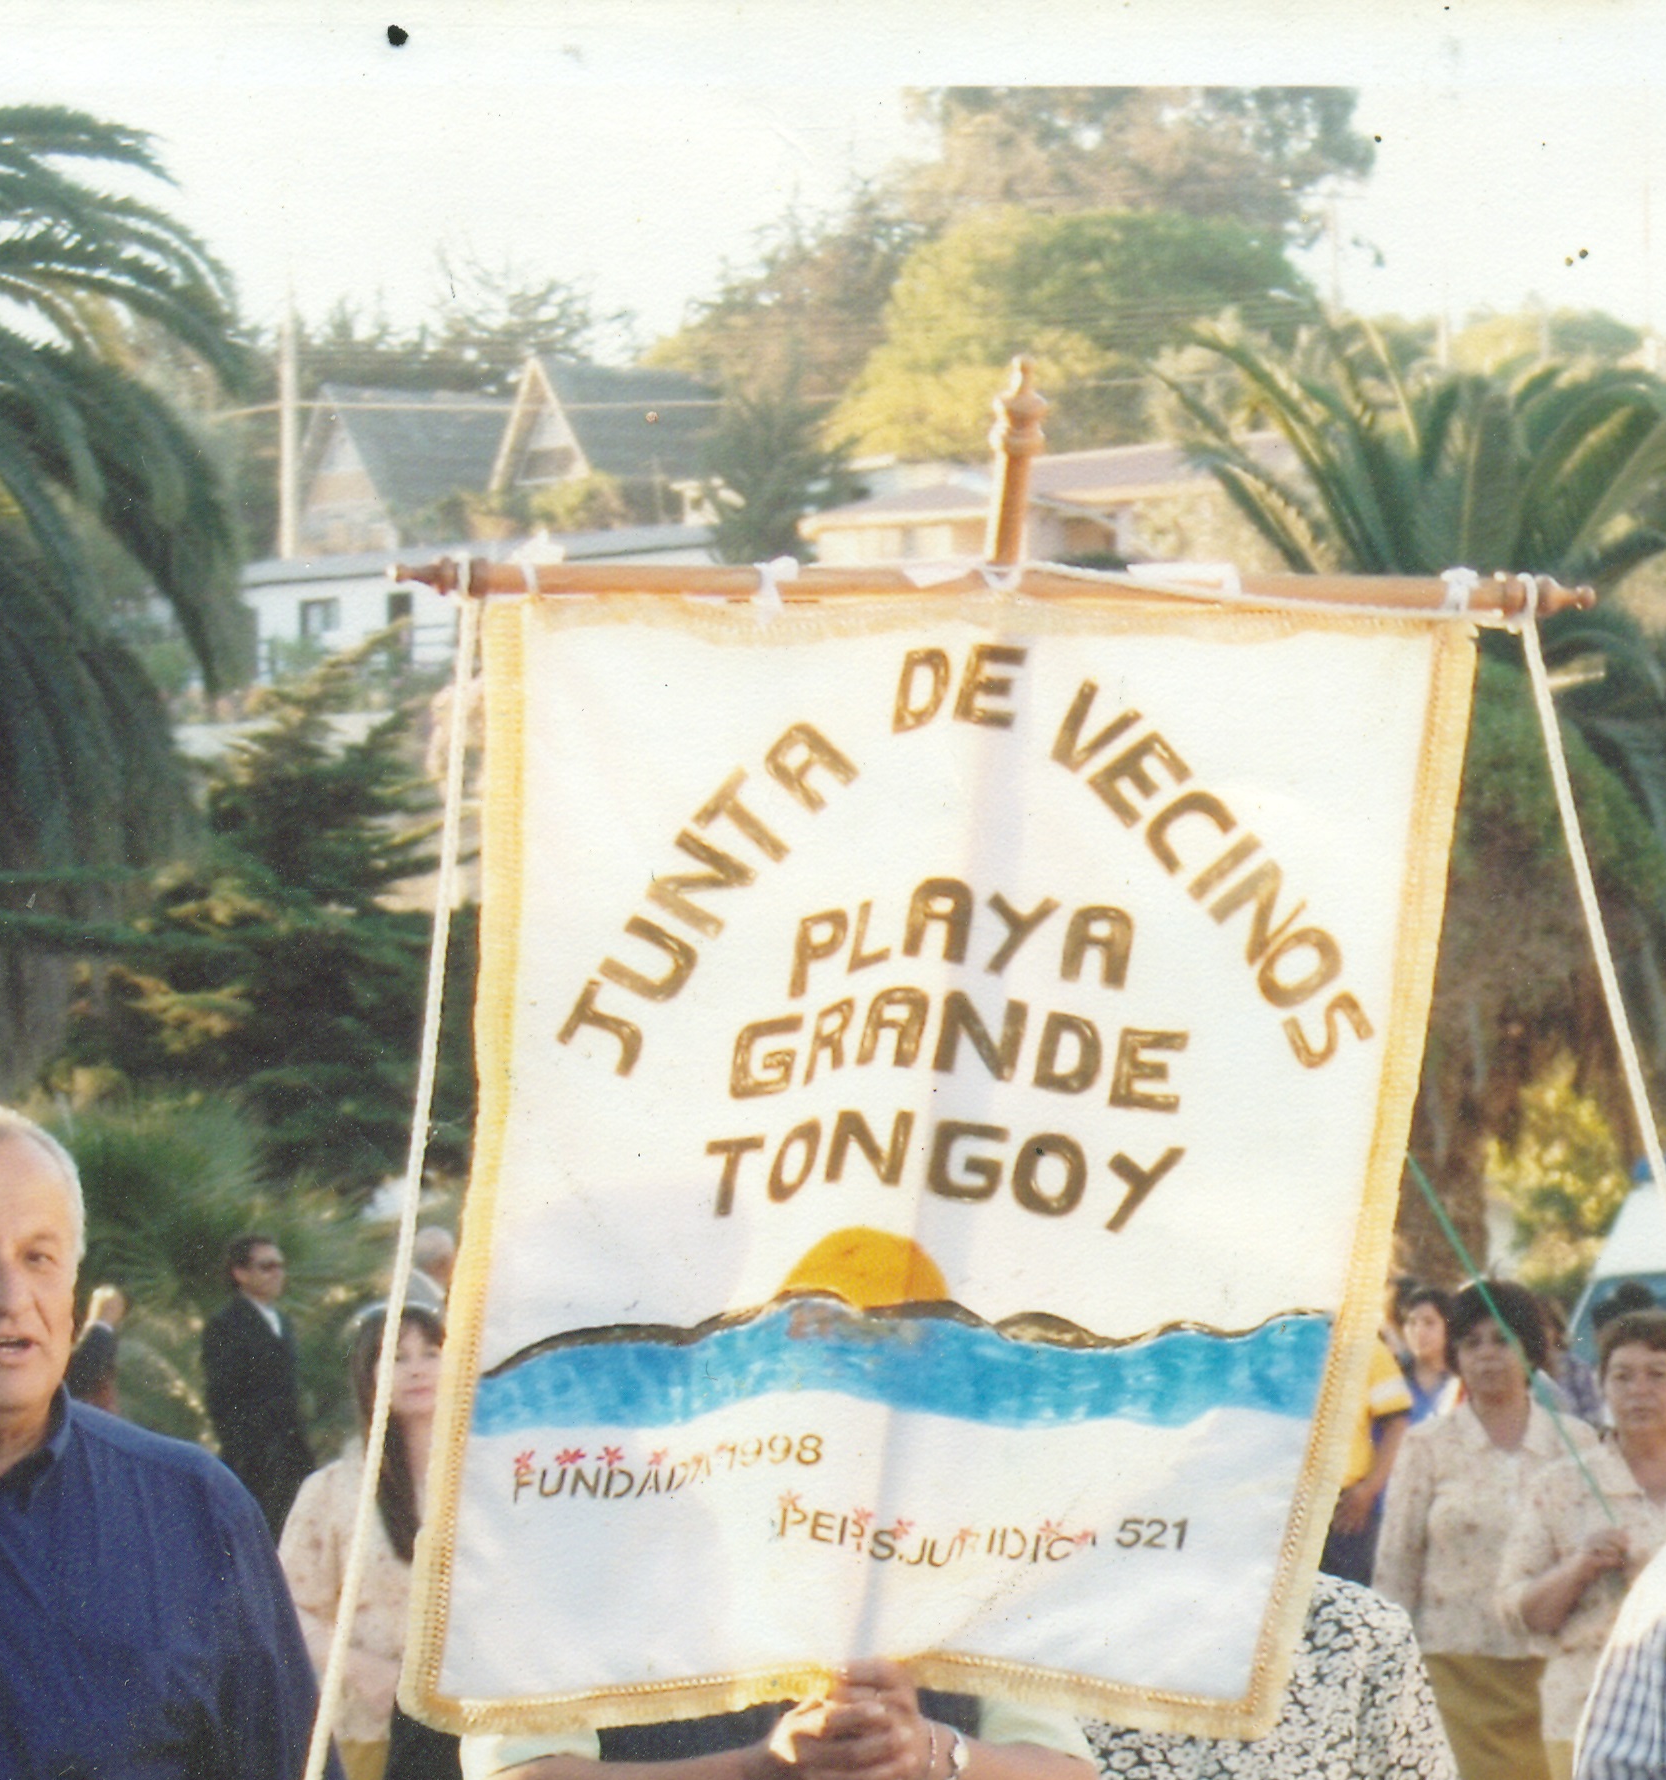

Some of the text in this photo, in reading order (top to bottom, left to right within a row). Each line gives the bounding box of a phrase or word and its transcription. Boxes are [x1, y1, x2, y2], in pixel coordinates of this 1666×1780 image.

[558, 643, 1376, 1076] JUNTA DE VECINOS
[789, 878, 1135, 998] PLAYA
[729, 987, 1189, 1114] GRANDE
[705, 1109, 1186, 1232] TONGOY
[1114, 1517, 1189, 1550] 521
